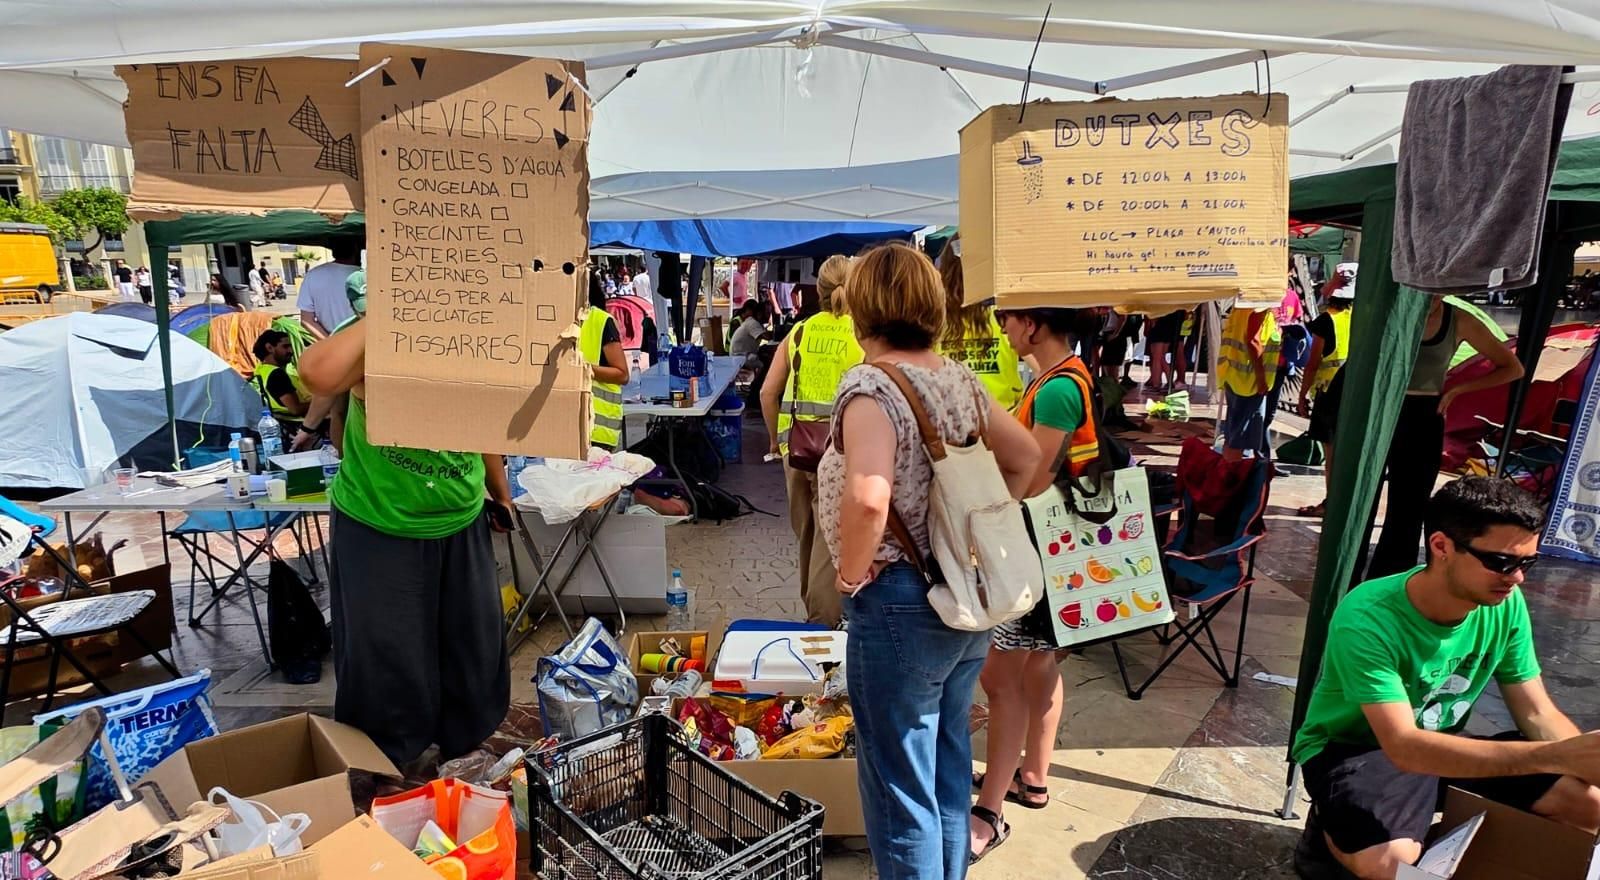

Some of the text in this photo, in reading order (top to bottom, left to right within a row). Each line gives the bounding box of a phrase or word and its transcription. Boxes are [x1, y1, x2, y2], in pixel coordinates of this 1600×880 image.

[155, 64, 281, 105] ENS FA
[393, 99, 544, 144] NEVERES
[1054, 108, 1253, 157] DUTXES
[166, 121, 282, 174] FALTA
[397, 147, 493, 174] BOTELLES
[397, 178, 500, 197] CONGELADA
[1082, 171, 1104, 186] DE
[1121, 170, 1171, 185] 12:00h
[1183, 170, 1192, 182] A
[393, 199, 482, 220] GRANERA
[1083, 199, 1105, 212] DE
[1120, 199, 1170, 212] 20:00h
[1181, 199, 1189, 209] A
[391, 220, 494, 242] PRECINTE
[1082, 231, 1120, 242] LLOC
[391, 242, 498, 265] BATERIES
[1140, 248, 1156, 262] gel
[391, 265, 489, 285] EXTERNES
[391, 288, 524, 305] POALS PER AL
[390, 330, 523, 364] PISSARRES
[806, 336, 848, 358] LLUITA
[380, 447, 434, 477] L'ESCOLA
